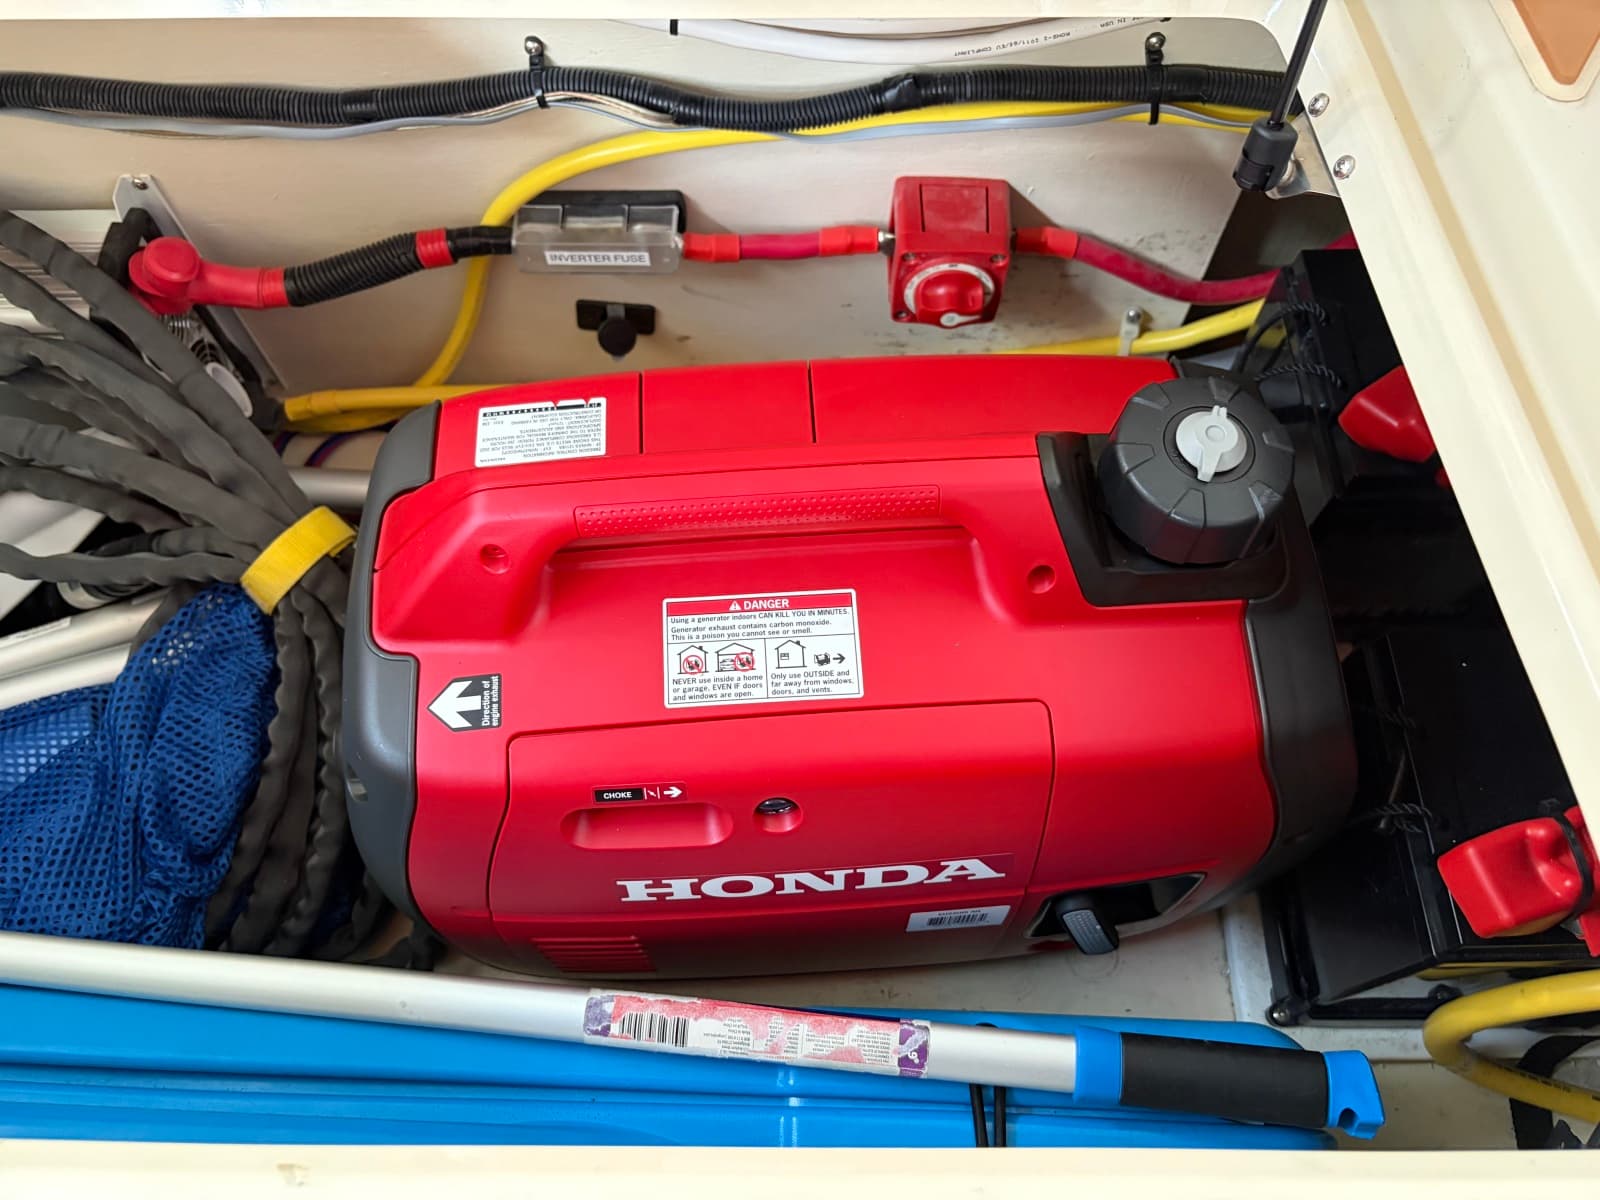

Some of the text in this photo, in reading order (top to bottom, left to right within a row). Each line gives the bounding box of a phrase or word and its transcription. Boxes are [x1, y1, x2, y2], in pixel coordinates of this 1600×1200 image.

[1100, 20, 1114, 28] USA
[954, 46, 992, 57] COMPLIANT
[549, 253, 647, 263] INVERTER FUSE
[743, 599, 790, 610] DANGER
[697, 614, 730, 623] generator
[732, 612, 756, 620] indoors
[738, 622, 767, 630] contains
[702, 632, 725, 640] poison
[726, 631, 740, 639] you
[742, 629, 766, 637] cannot
[803, 670, 834, 678] OUTSIDE
[712, 683, 732, 691] EVEN
[481, 680, 490, 726] Direction of
[490, 675, 500, 726] engine exhaust
[603, 791, 633, 800] CHOKE
[616, 858, 1006, 902] HONDA
